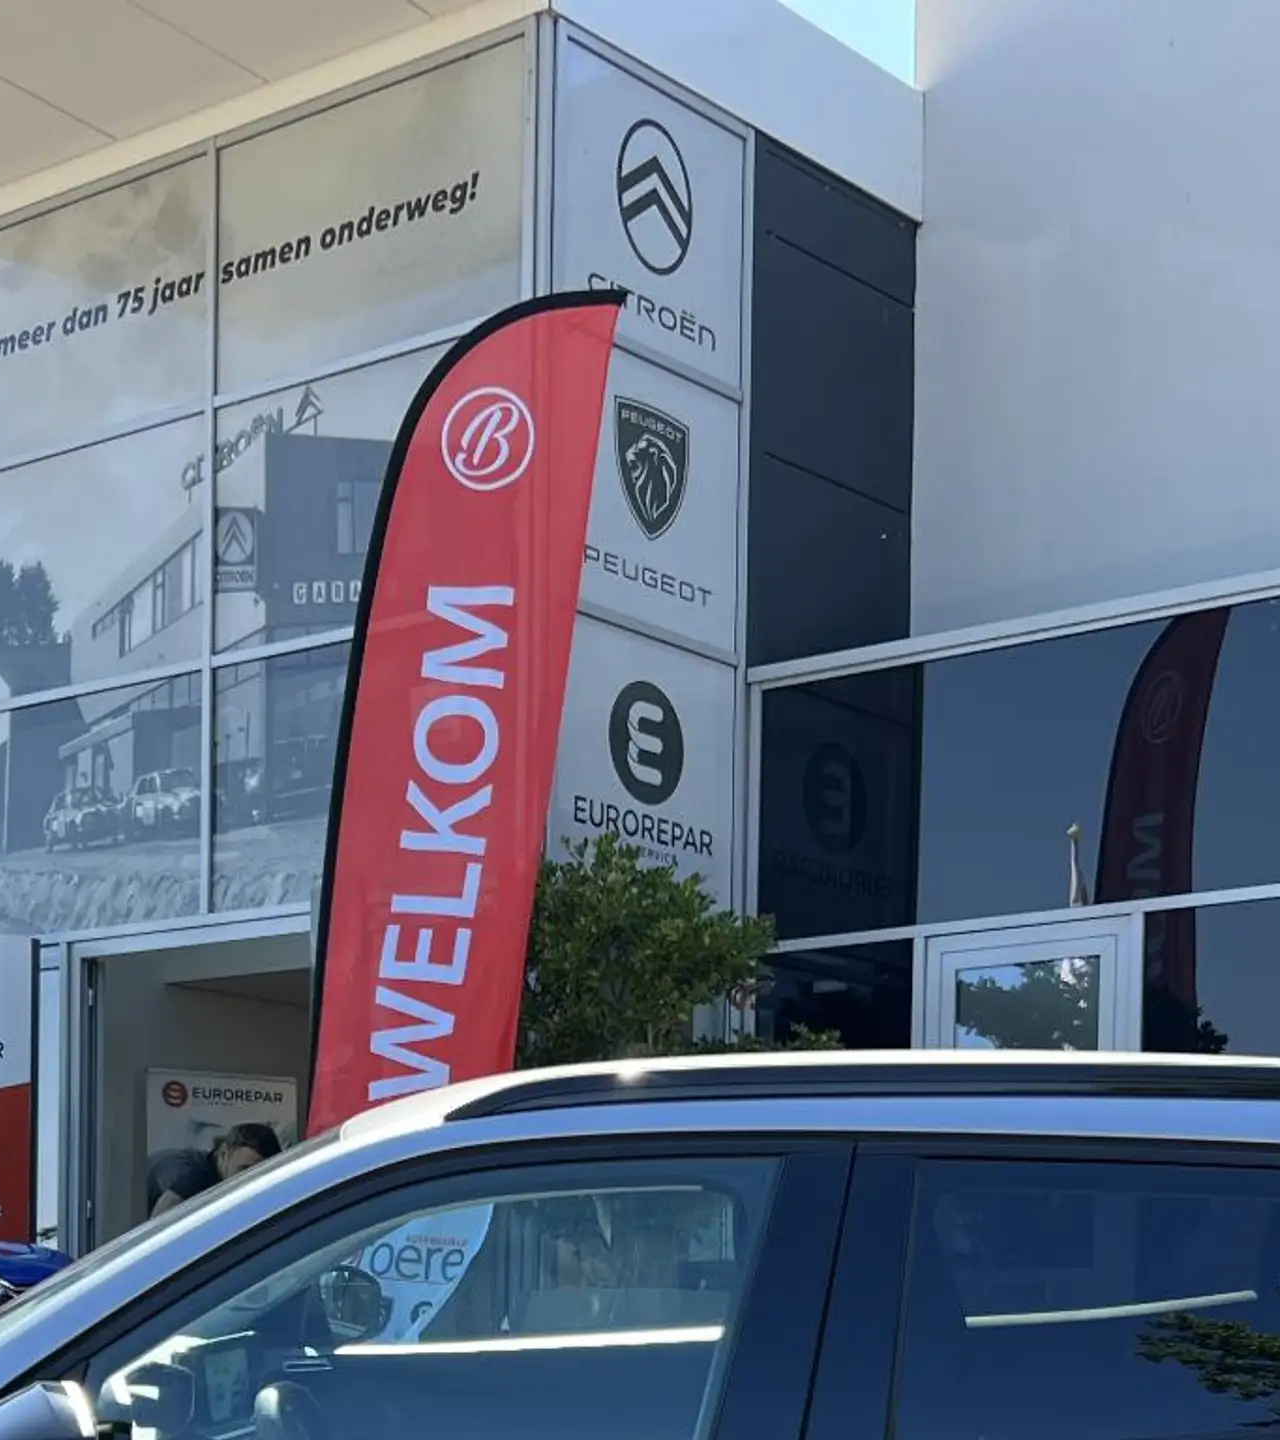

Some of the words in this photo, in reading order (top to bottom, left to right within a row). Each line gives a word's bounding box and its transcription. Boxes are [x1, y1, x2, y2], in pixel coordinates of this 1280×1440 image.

[62, 303, 108, 336] dan
[116, 287, 145, 319] 75
[148, 271, 204, 315] jaar
[221, 234, 311, 284] samen
[320, 171, 479, 250] onderweg!
[622, 408, 683, 442] PEUGEOT
[584, 544, 712, 607] PEUGEOT
[368, 584, 514, 1102] WELKOM
[573, 795, 713, 856] EUROREPAR
[192, 1087, 283, 1103] EUROREPAR
[370, 1242, 465, 1282] oere
